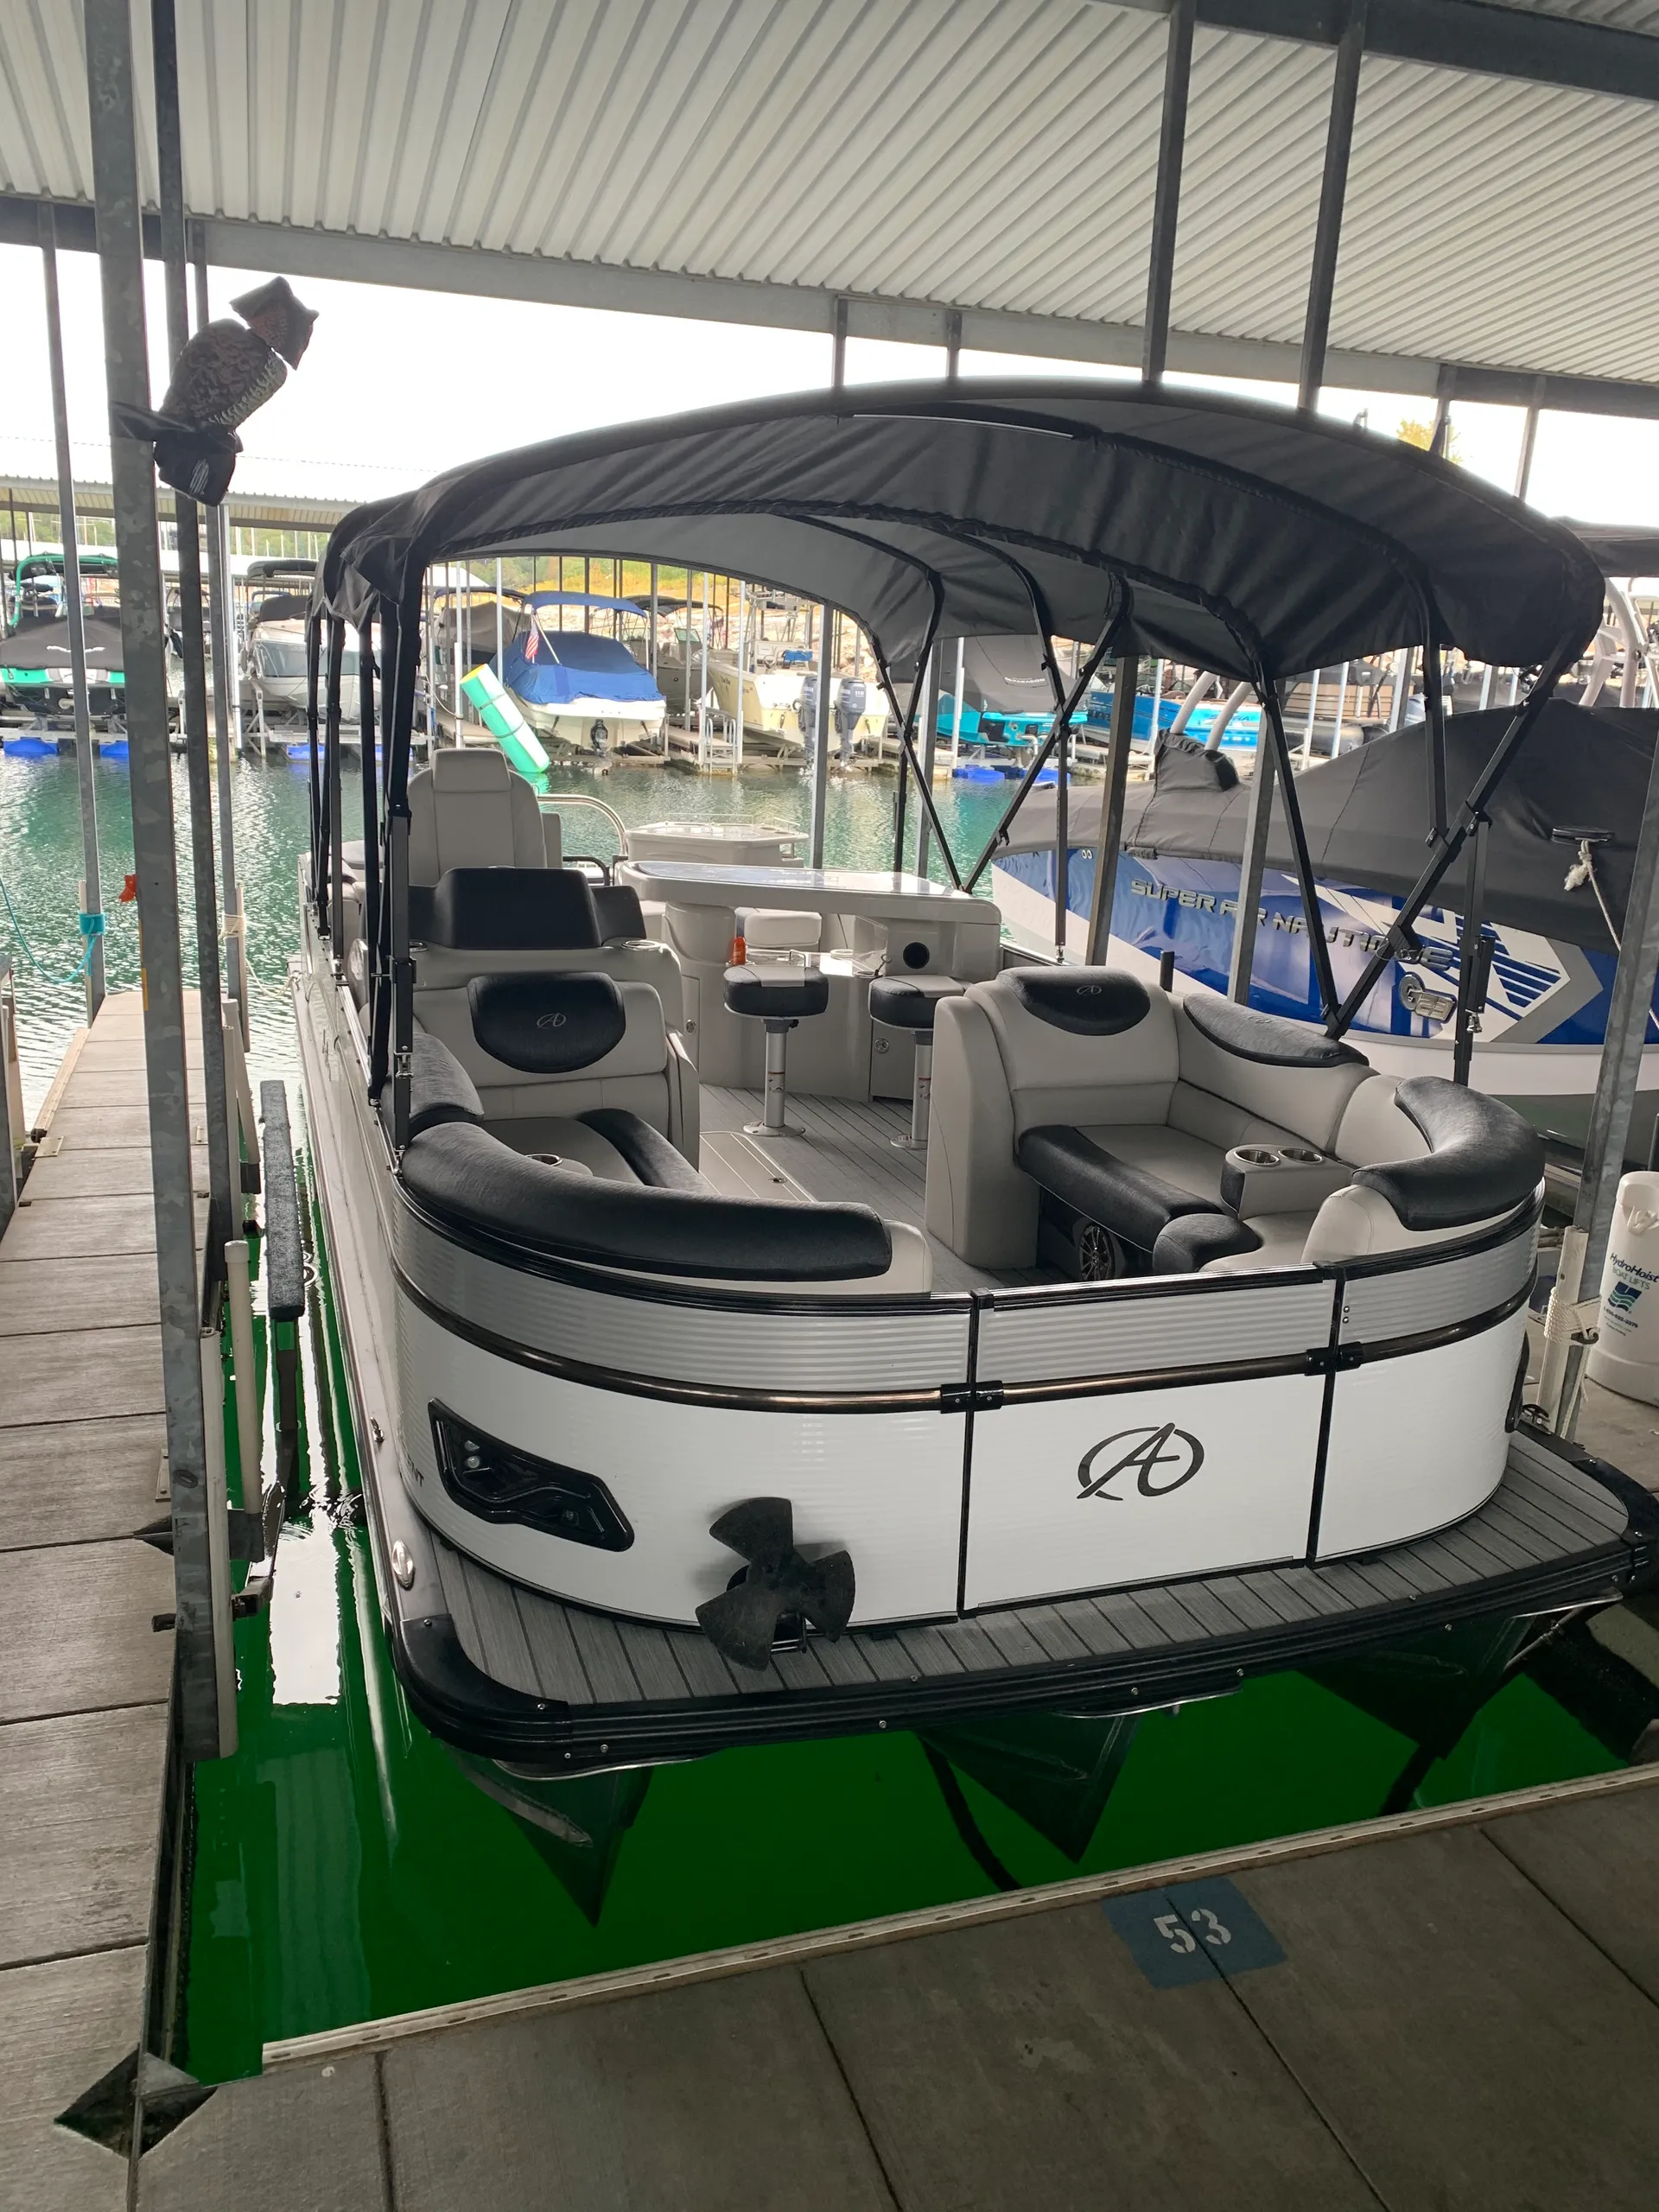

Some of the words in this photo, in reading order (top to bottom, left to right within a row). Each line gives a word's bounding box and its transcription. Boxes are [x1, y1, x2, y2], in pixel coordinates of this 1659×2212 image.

[1131, 878, 1217, 912] SUPER
[1219, 899, 1268, 926] AR
[1610, 1252, 1659, 1283] HydroHoist
[1629, 1277, 1651, 1290] LIFTS
[1154, 1908, 1231, 1953] 53
